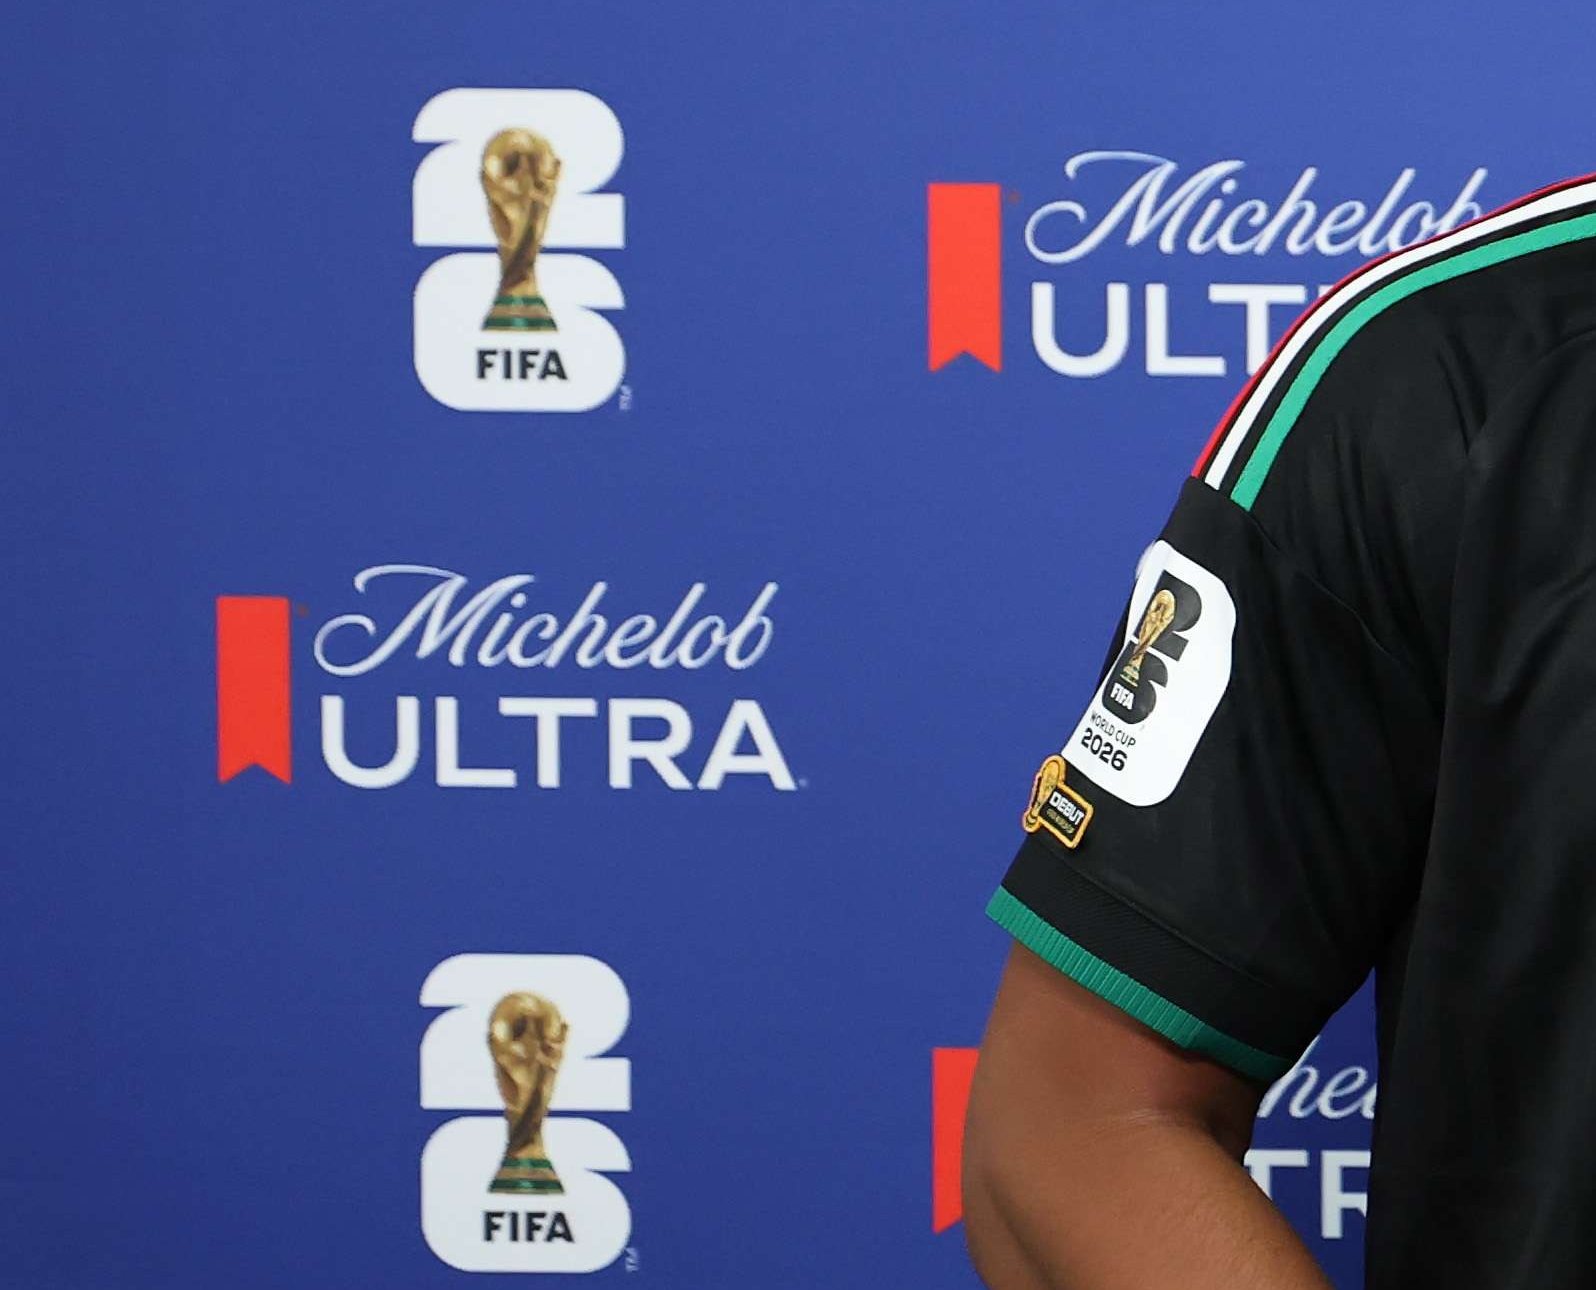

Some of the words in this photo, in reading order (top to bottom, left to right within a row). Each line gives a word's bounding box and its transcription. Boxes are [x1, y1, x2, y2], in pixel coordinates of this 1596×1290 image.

[1032, 282, 1320, 377] ULT
[477, 349, 568, 380] FIFA
[314, 565, 778, 675] Michelob
[1110, 683, 1135, 710] FIFA
[321, 695, 796, 790] ULTRA
[1080, 728, 1128, 771] 2026
[1090, 712, 1116, 738] WORLD
[1115, 731, 1137, 750] CUP
[1049, 791, 1085, 826] DEBUT
[484, 1211, 574, 1243] FIFA
